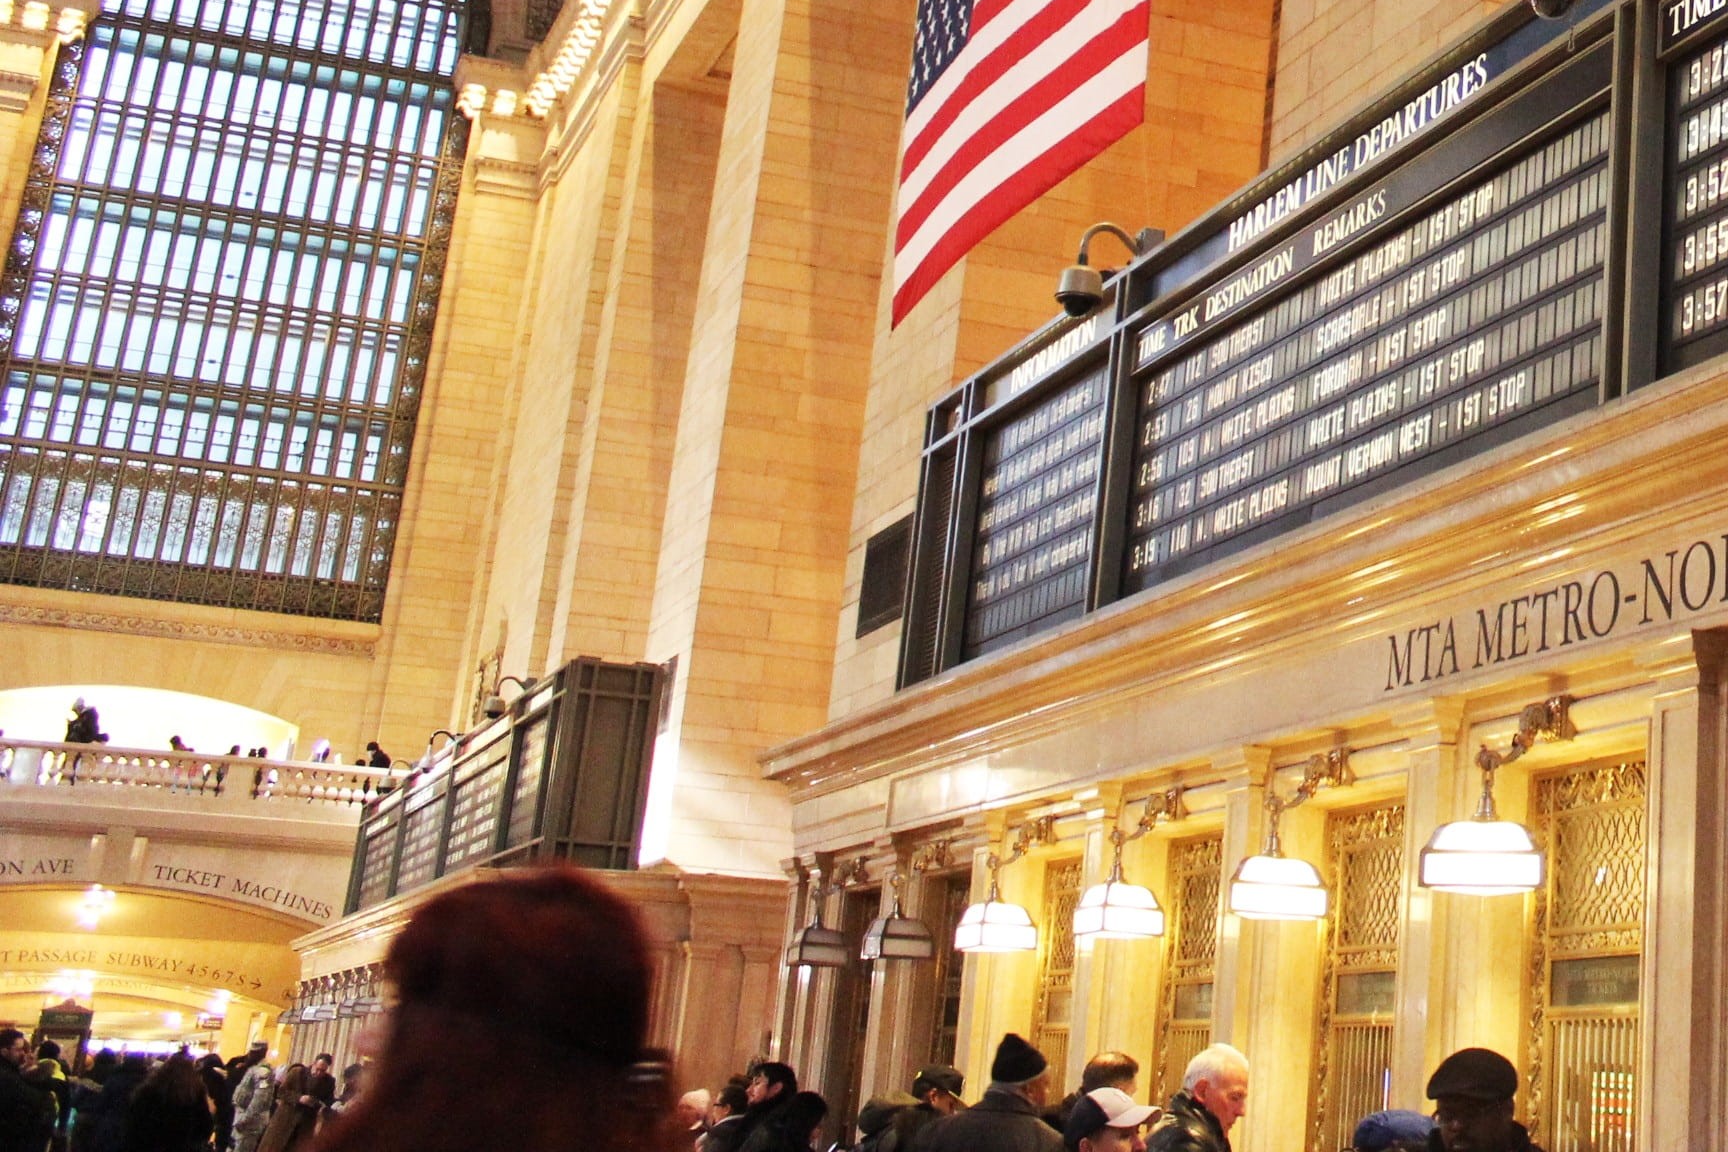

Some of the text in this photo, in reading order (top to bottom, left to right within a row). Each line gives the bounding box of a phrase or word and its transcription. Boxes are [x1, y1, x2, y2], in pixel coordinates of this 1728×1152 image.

[1228, 52, 1488, 252] HARLEM LINE DEPARTURES
[1138, 189, 1386, 362] TIME TRK DESTINATION REMARKS
[1206, 372, 1238, 412] MOUNT
[1242, 352, 1274, 394] KISCO
[1317, 295, 1380, 354] SCARSDALE
[1403, 270, 1426, 308] 1ST
[1431, 247, 1465, 292] STOP
[1211, 316, 1265, 369] SOUTHEAST
[1320, 262, 1356, 306] WHITE
[1361, 235, 1406, 284] PLAINS
[1429, 206, 1453, 245] 1ST
[1459, 183, 1494, 229] STOP
[1682, 279, 1728, 331] 3:57
[1010, 315, 1097, 394] INFORMATION
[1200, 449, 1254, 498] SOUTHEAST
[1310, 406, 1345, 446] WHITE
[1350, 380, 1397, 429] PLAINS
[1419, 359, 1444, 396] 1ST
[1450, 338, 1484, 382] STOP
[1221, 407, 1253, 447] WHITE
[1256, 385, 1296, 431] PLAINS
[1312, 351, 1363, 401] FORDHAM
[1384, 329, 1407, 365] 1ST
[1413, 308, 1447, 350] STOP
[1214, 498, 1245, 535] WHITE
[1249, 479, 1289, 520] PLAINS
[1306, 456, 1342, 495] MOUNT
[1348, 432, 1393, 478] VERNON
[1399, 414, 1432, 454] WEST
[1456, 392, 1482, 430] 1ST
[1488, 372, 1525, 416] STOP
[1383, 614, 1460, 692] MTA
[32, 859, 75, 874] AVE
[154, 864, 333, 920] TICKET MACHINES
[18, 949, 97, 964] PASSAGE
[106, 951, 183, 973] SUBWAY
